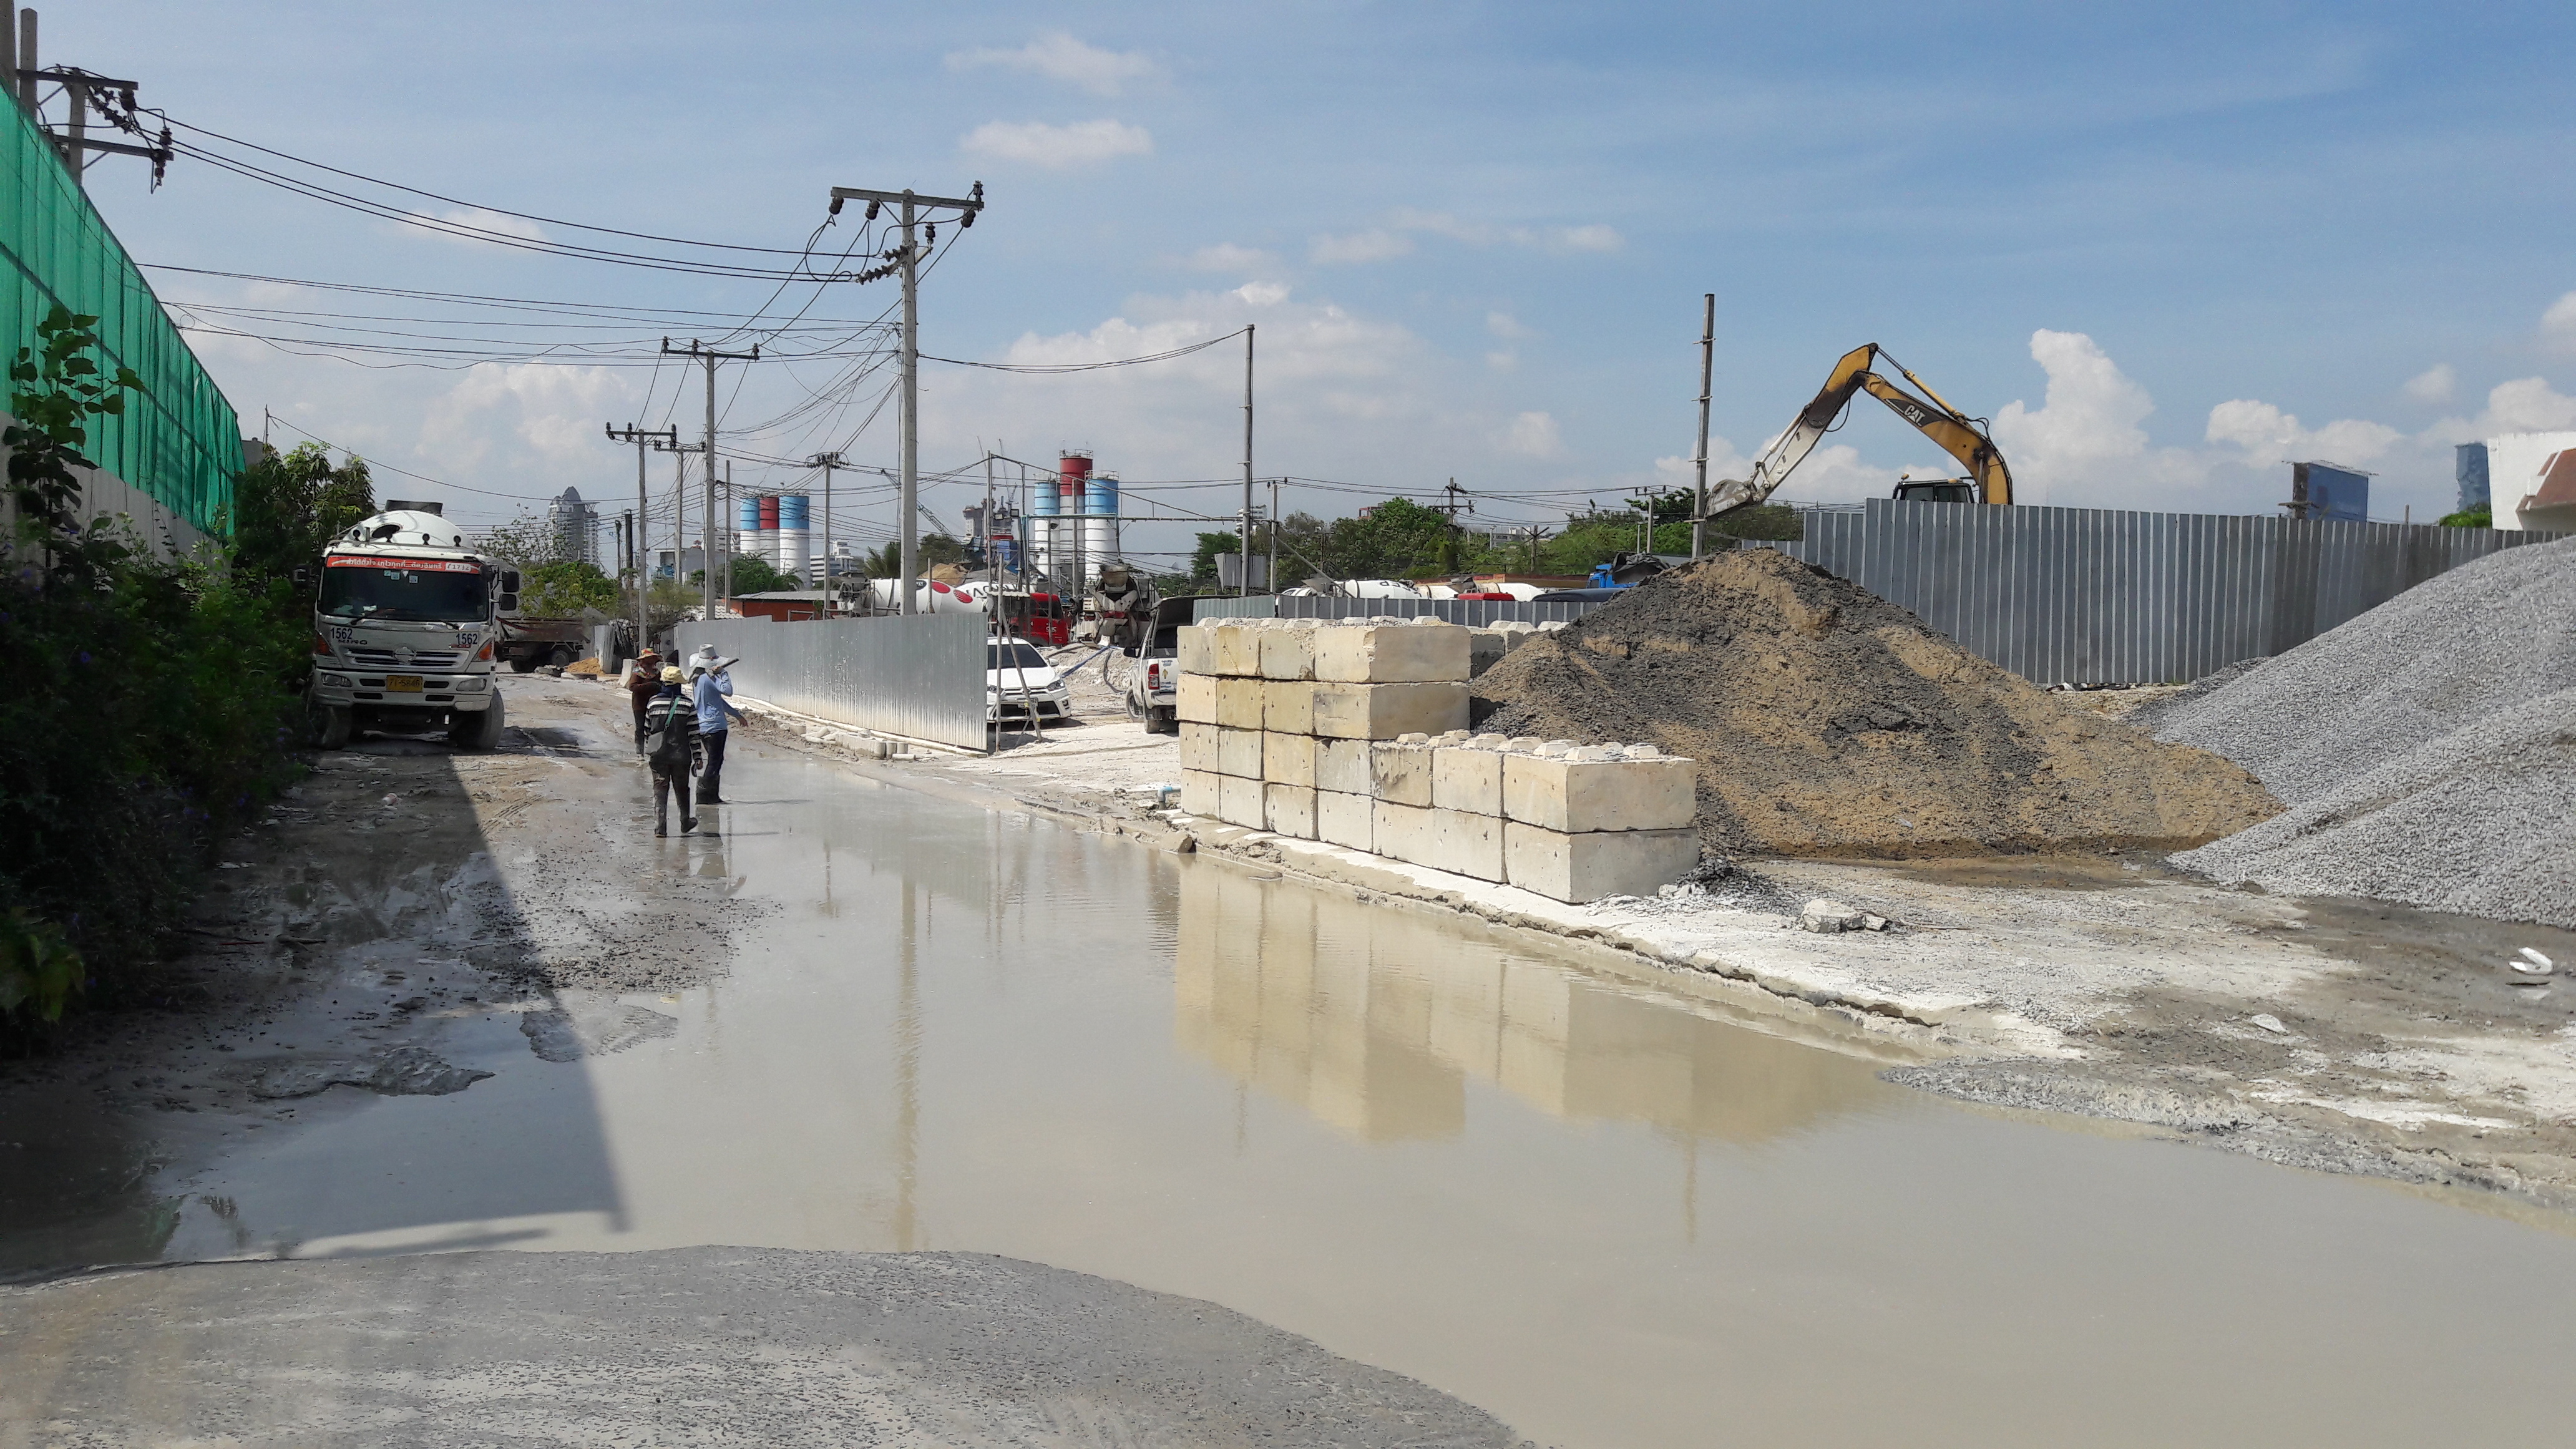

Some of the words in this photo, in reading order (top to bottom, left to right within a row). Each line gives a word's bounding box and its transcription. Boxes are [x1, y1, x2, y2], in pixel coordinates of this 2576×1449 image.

[1904, 404, 1926, 424] CAT
[329, 627, 353, 640] 1562
[456, 633, 478, 645] 1562
